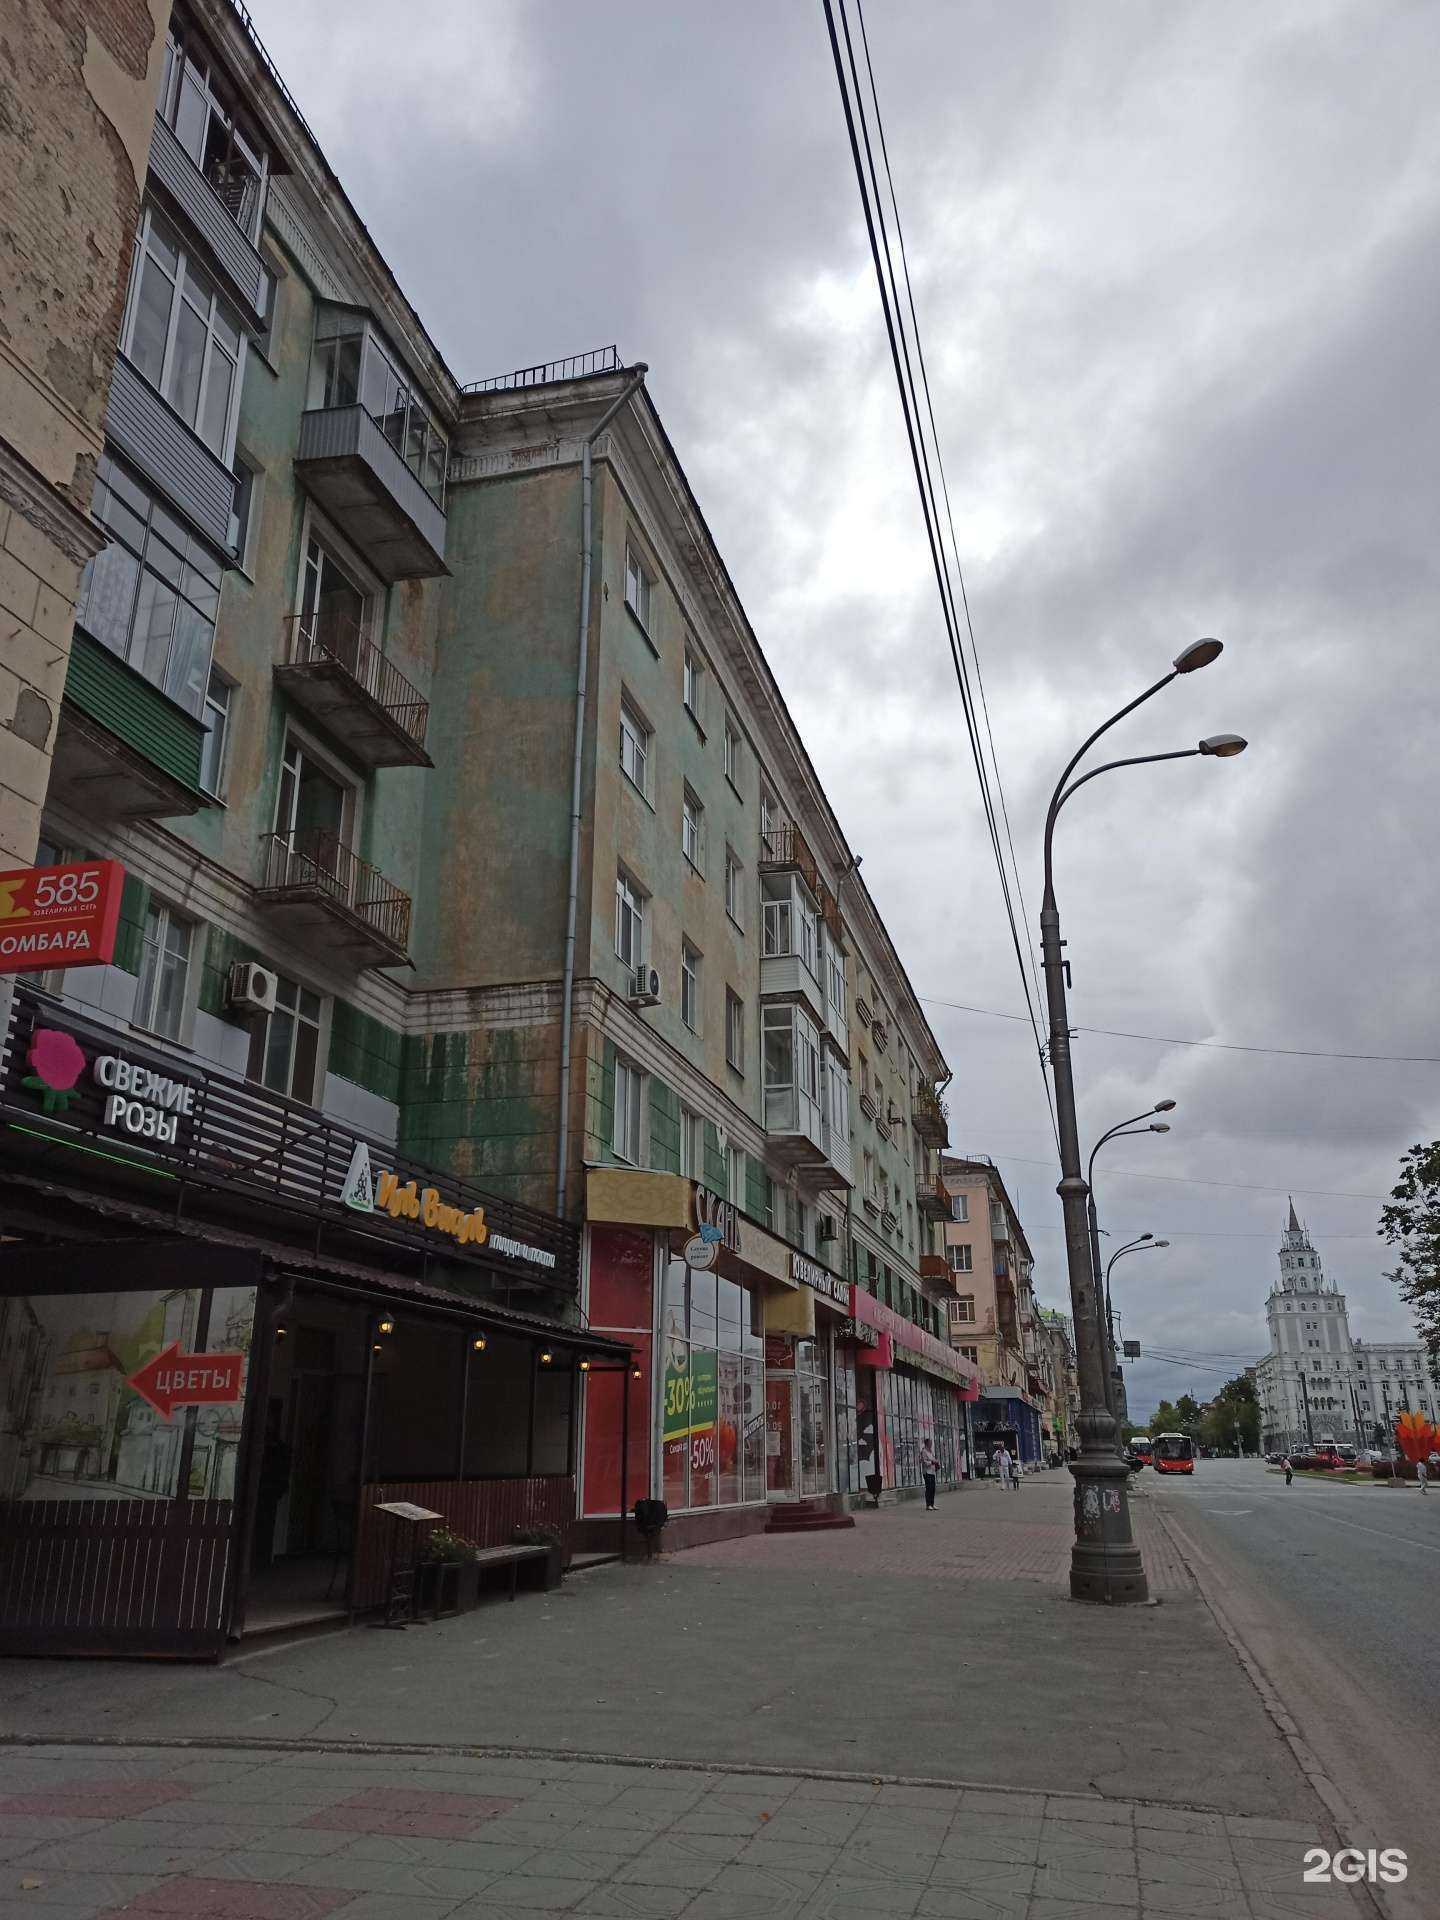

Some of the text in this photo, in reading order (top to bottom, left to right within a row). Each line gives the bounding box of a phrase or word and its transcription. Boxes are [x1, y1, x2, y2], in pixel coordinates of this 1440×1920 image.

[34, 870, 100, 907] 585
[0, 929, 91, 955] ОМБАРД
[94, 1055, 196, 1117] СВЕЖИЕ
[104, 1095, 178, 1145] РОЗЫ
[793, 1252, 831, 1295] ЮВЕЛИРНЫЙ
[156, 1369, 232, 1395] ЦВЕТЫ
